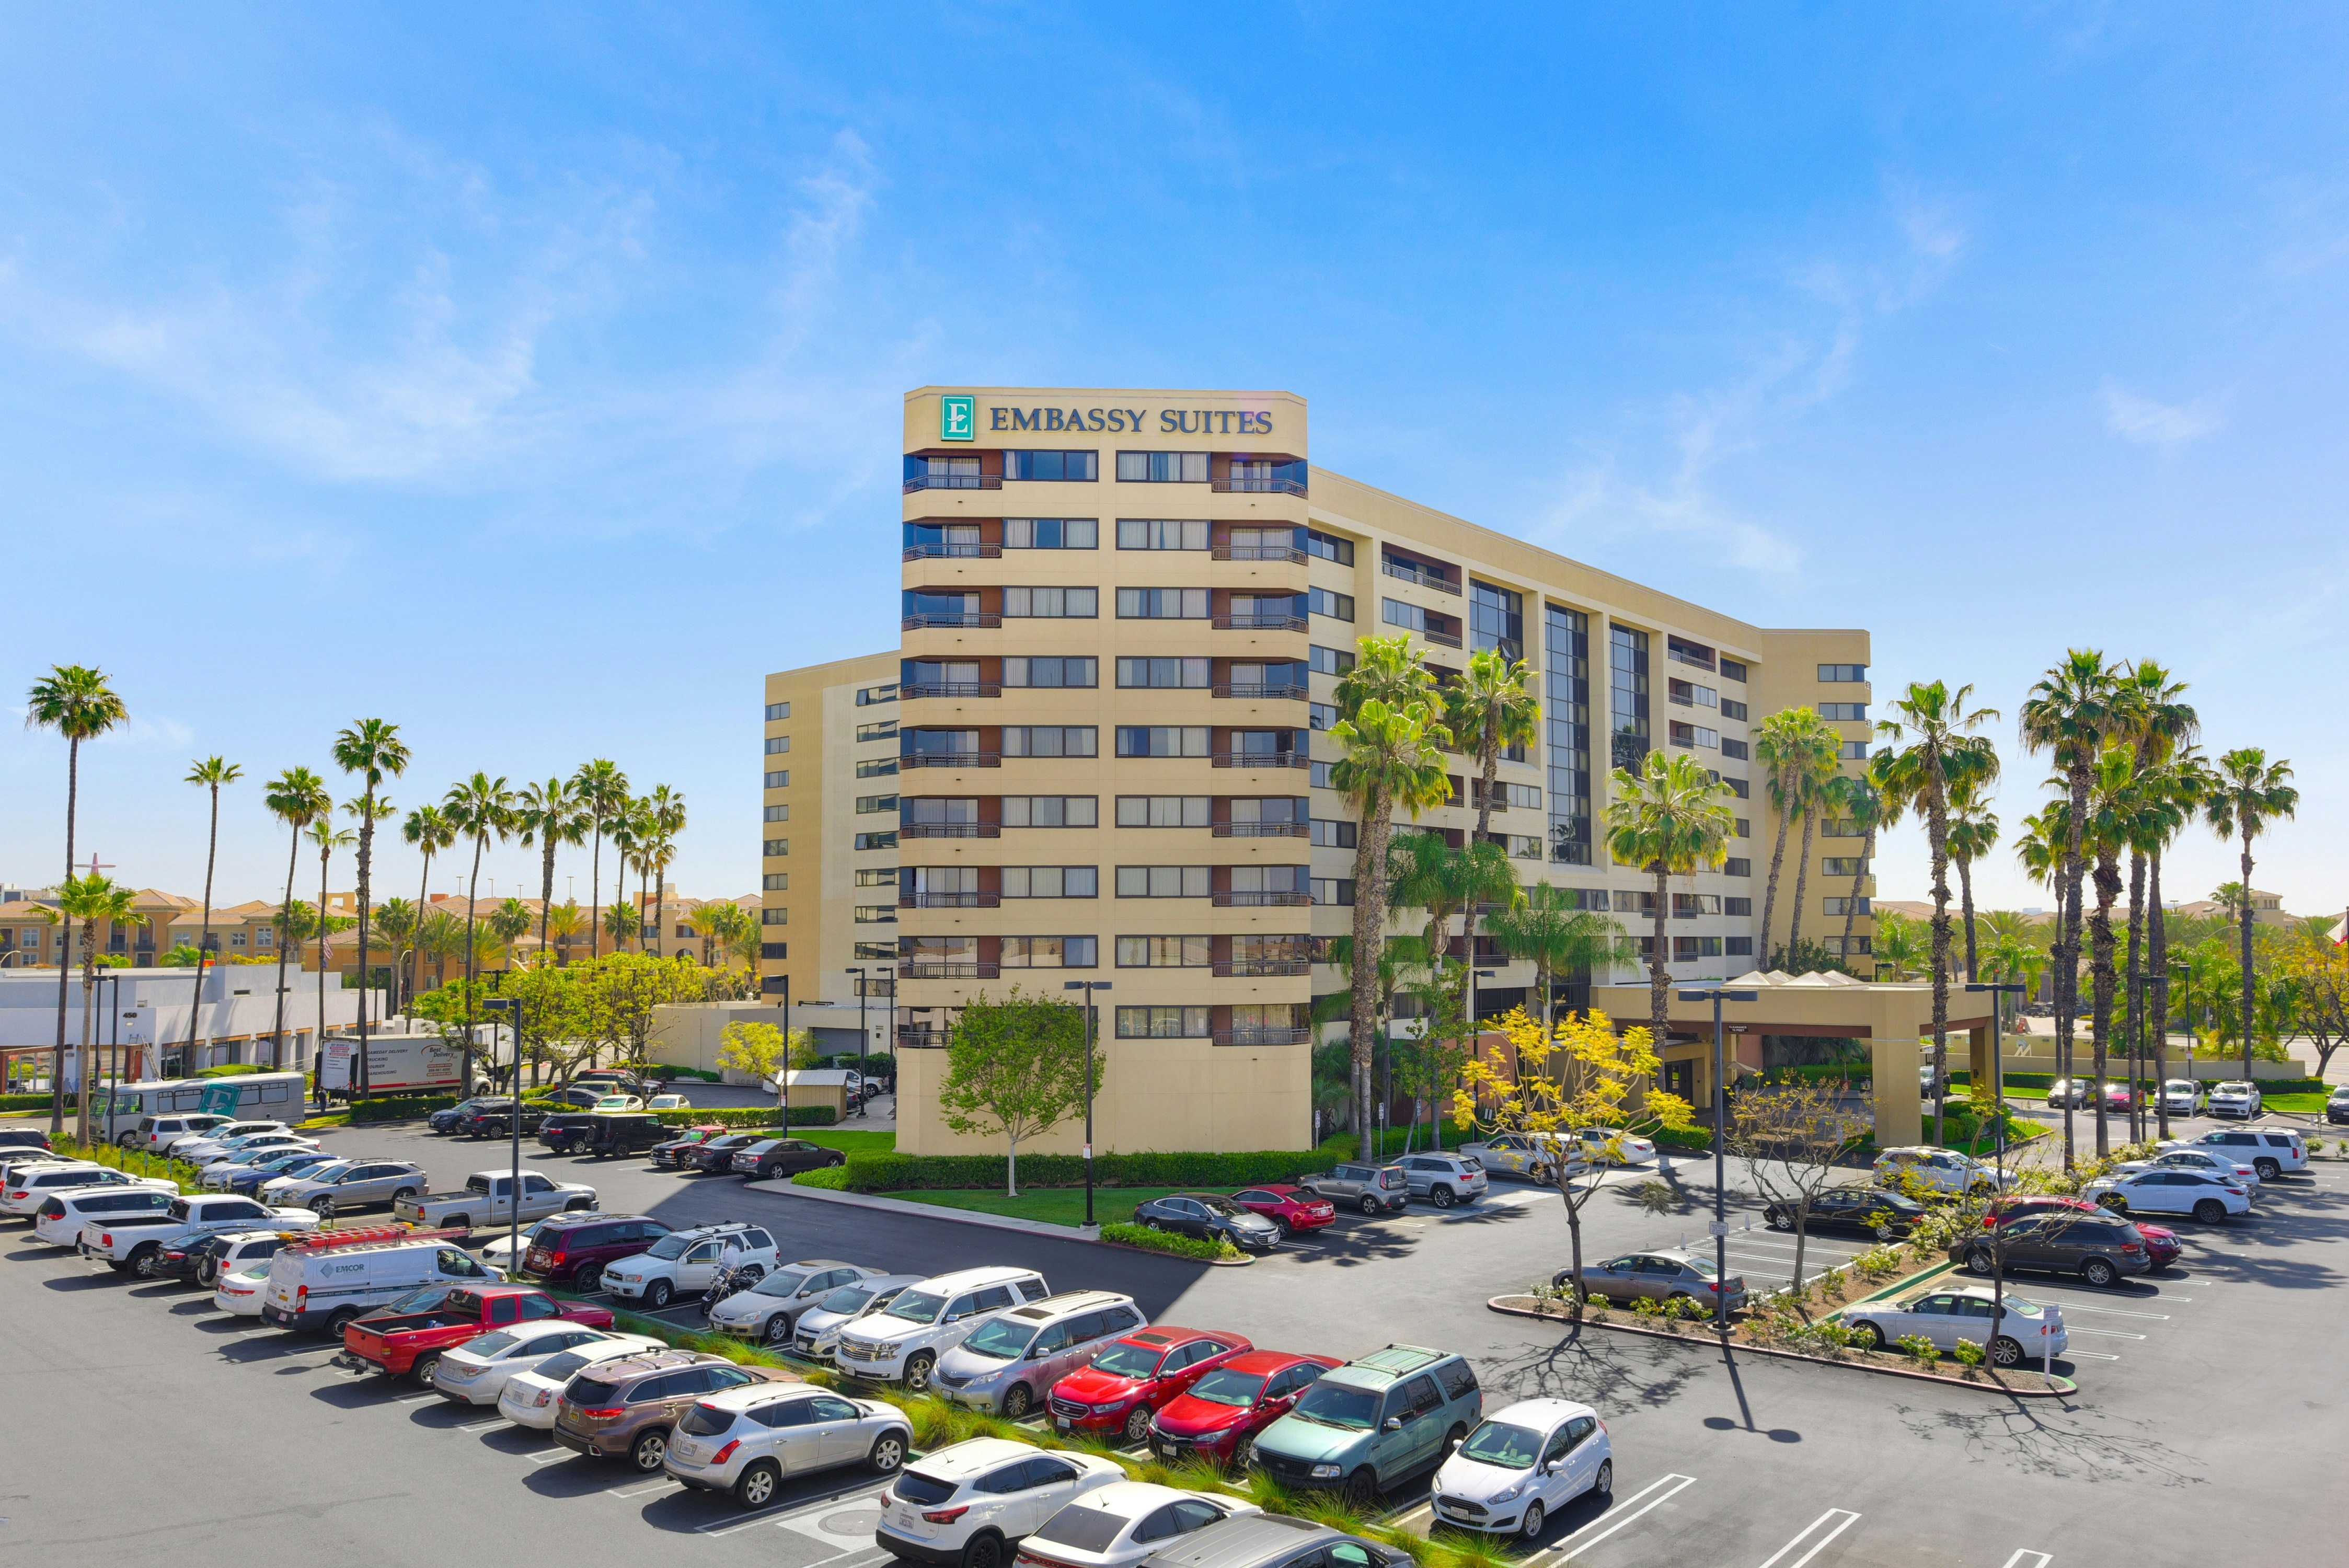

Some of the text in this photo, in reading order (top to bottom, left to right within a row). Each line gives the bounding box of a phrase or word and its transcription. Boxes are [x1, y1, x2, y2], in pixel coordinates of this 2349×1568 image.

[948, 403, 968, 433] E
[989, 407, 1273, 435] EMBASSY SUITES
[336, 1264, 365, 1273] EMCOR
